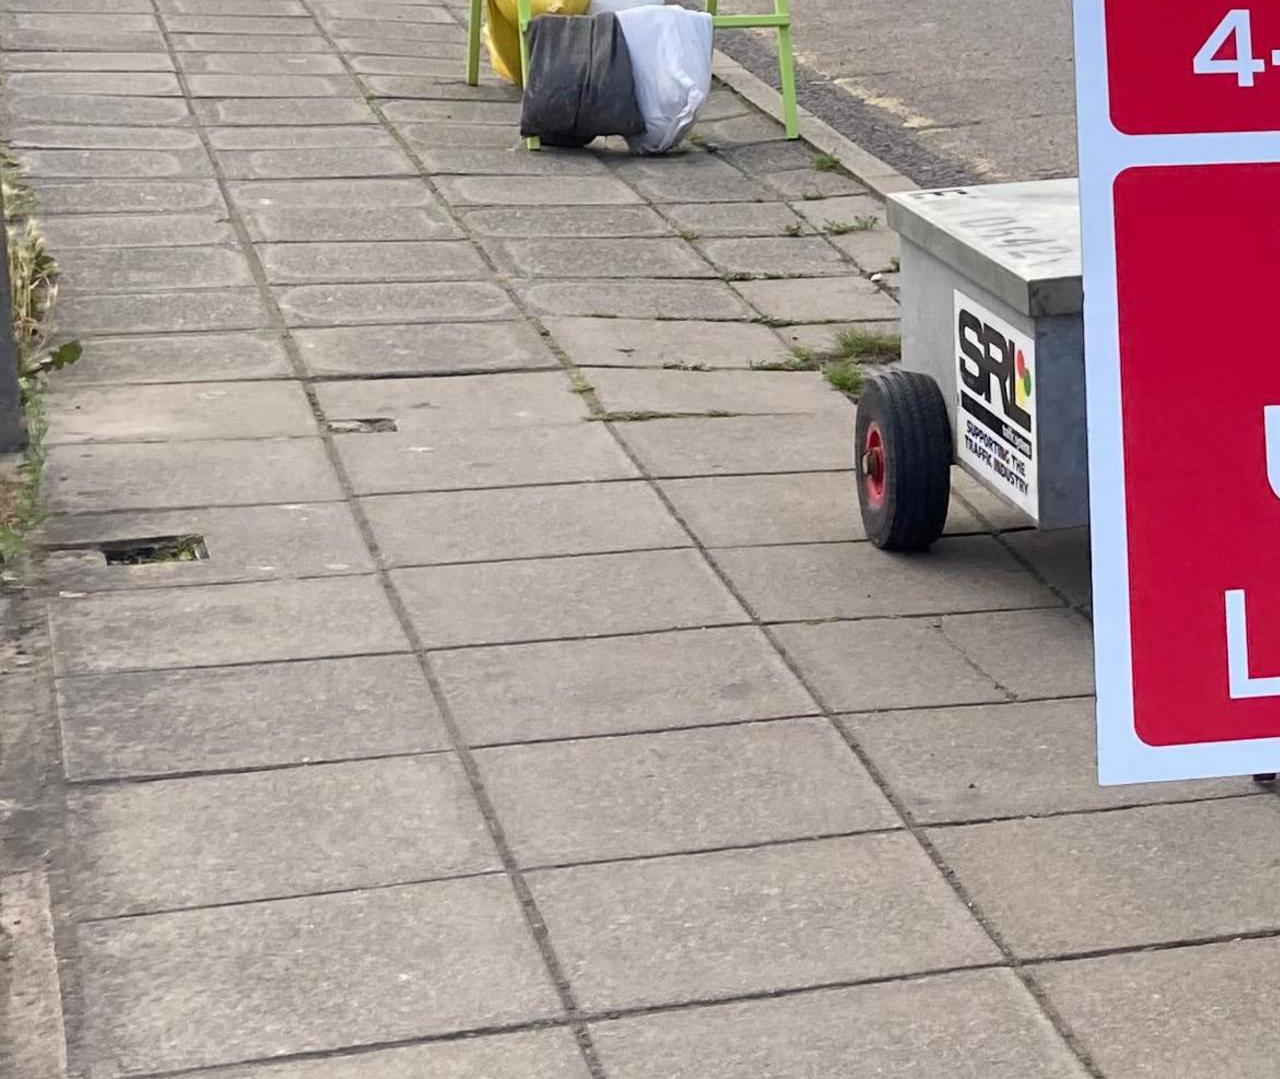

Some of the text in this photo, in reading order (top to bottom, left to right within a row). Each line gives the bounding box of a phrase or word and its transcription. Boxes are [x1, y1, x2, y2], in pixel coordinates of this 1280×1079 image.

[958, 308, 1032, 433] SRL
[964, 434, 993, 467] TRAFFIC
[993, 458, 1029, 496] INDUSTRY
[966, 419, 1010, 465] SUPPORTING
[1011, 454, 1026, 477] THE
